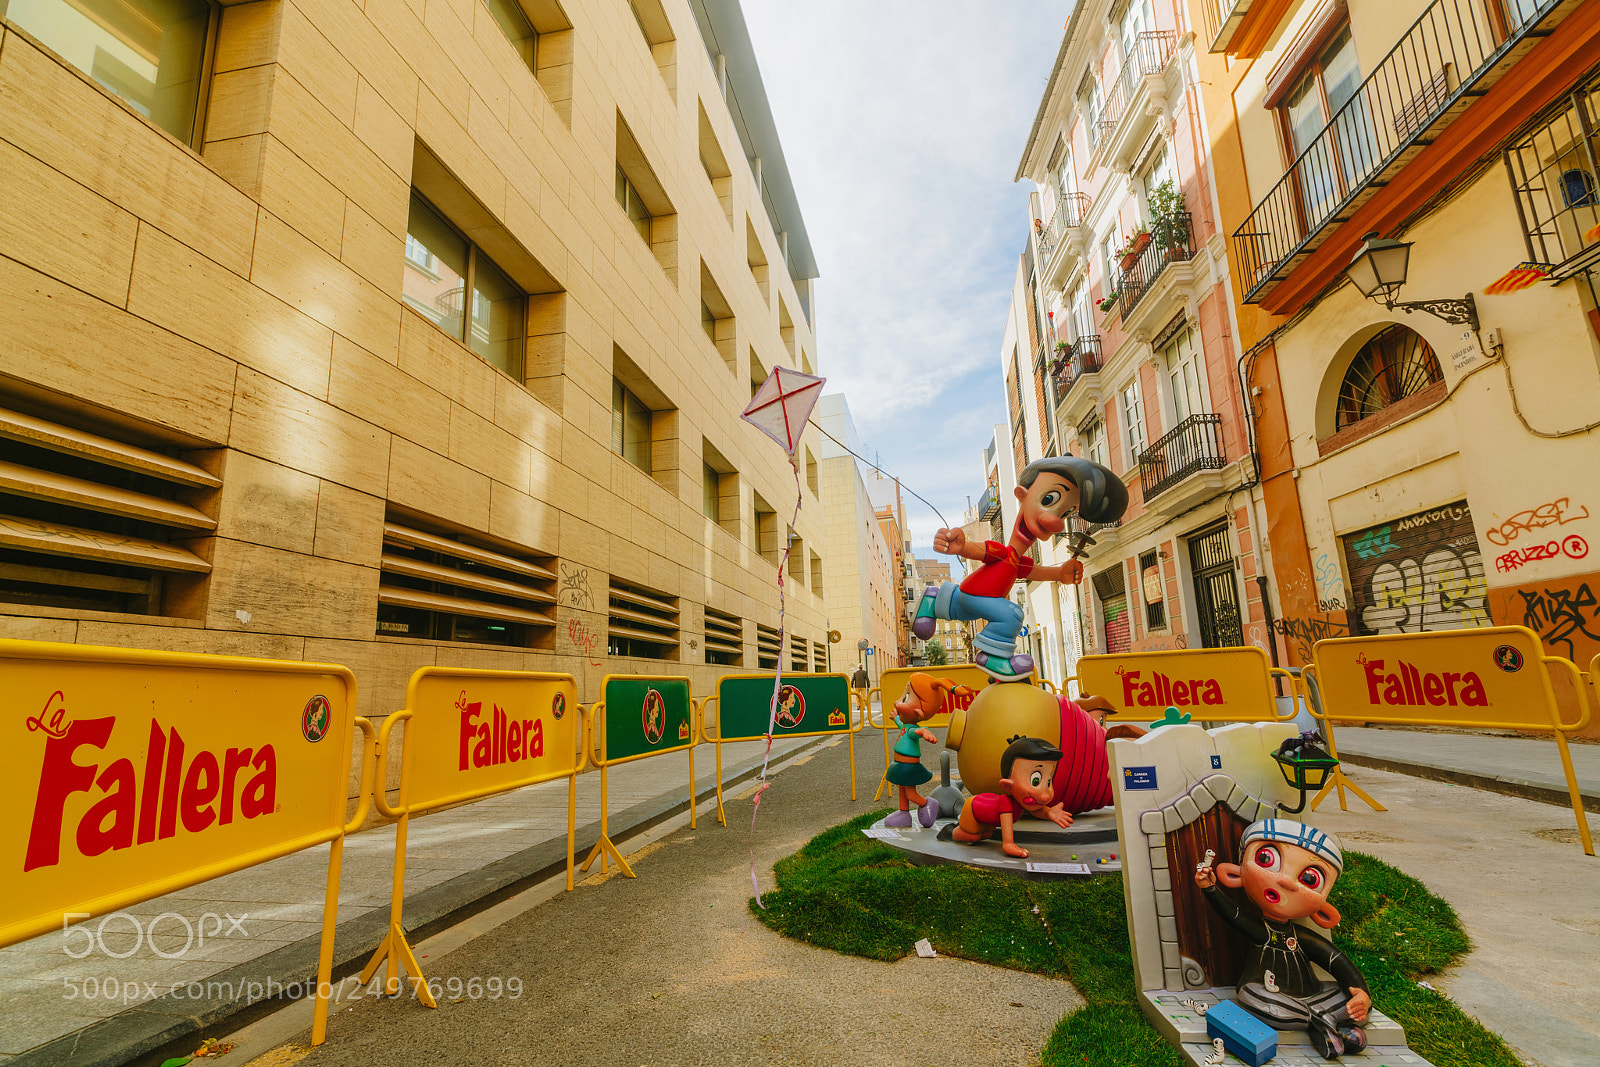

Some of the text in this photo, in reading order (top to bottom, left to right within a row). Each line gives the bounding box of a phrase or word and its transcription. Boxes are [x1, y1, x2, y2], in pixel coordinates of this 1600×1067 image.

[1495, 540, 1560, 573] ABRUZZO
[1121, 670, 1224, 707] Fallera
[1363, 659, 1489, 707] Fallera
[26, 690, 73, 738] La
[459, 701, 544, 771] Fallera
[1213, 758, 1219, 766] 8
[24, 716, 277, 872] Fallera
